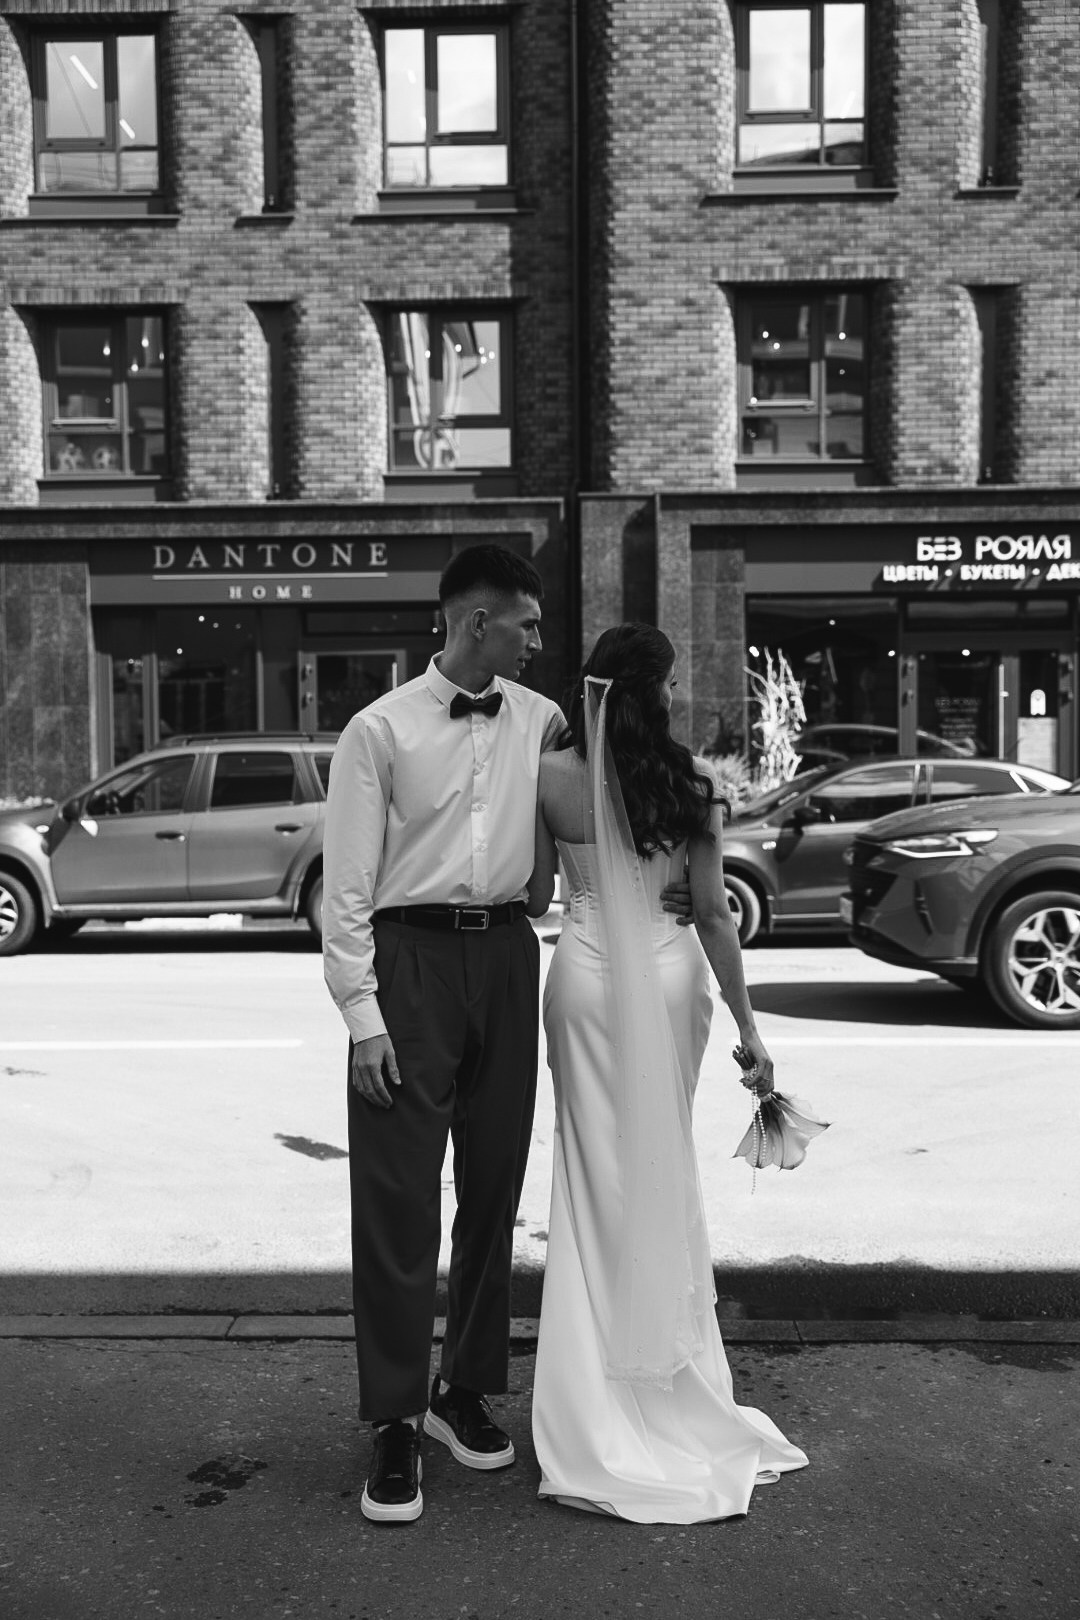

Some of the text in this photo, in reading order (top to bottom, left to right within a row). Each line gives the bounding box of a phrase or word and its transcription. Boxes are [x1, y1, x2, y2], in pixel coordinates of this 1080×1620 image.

[153, 543, 388, 568] DANTONE
[917, 534, 1071, 561] БЕЗ РОЯЛЯ
[883, 564, 939, 582] ЦВЕТЫ
[960, 563, 1026, 580] БУКЕТЫ
[229, 584, 313, 600] HOME
